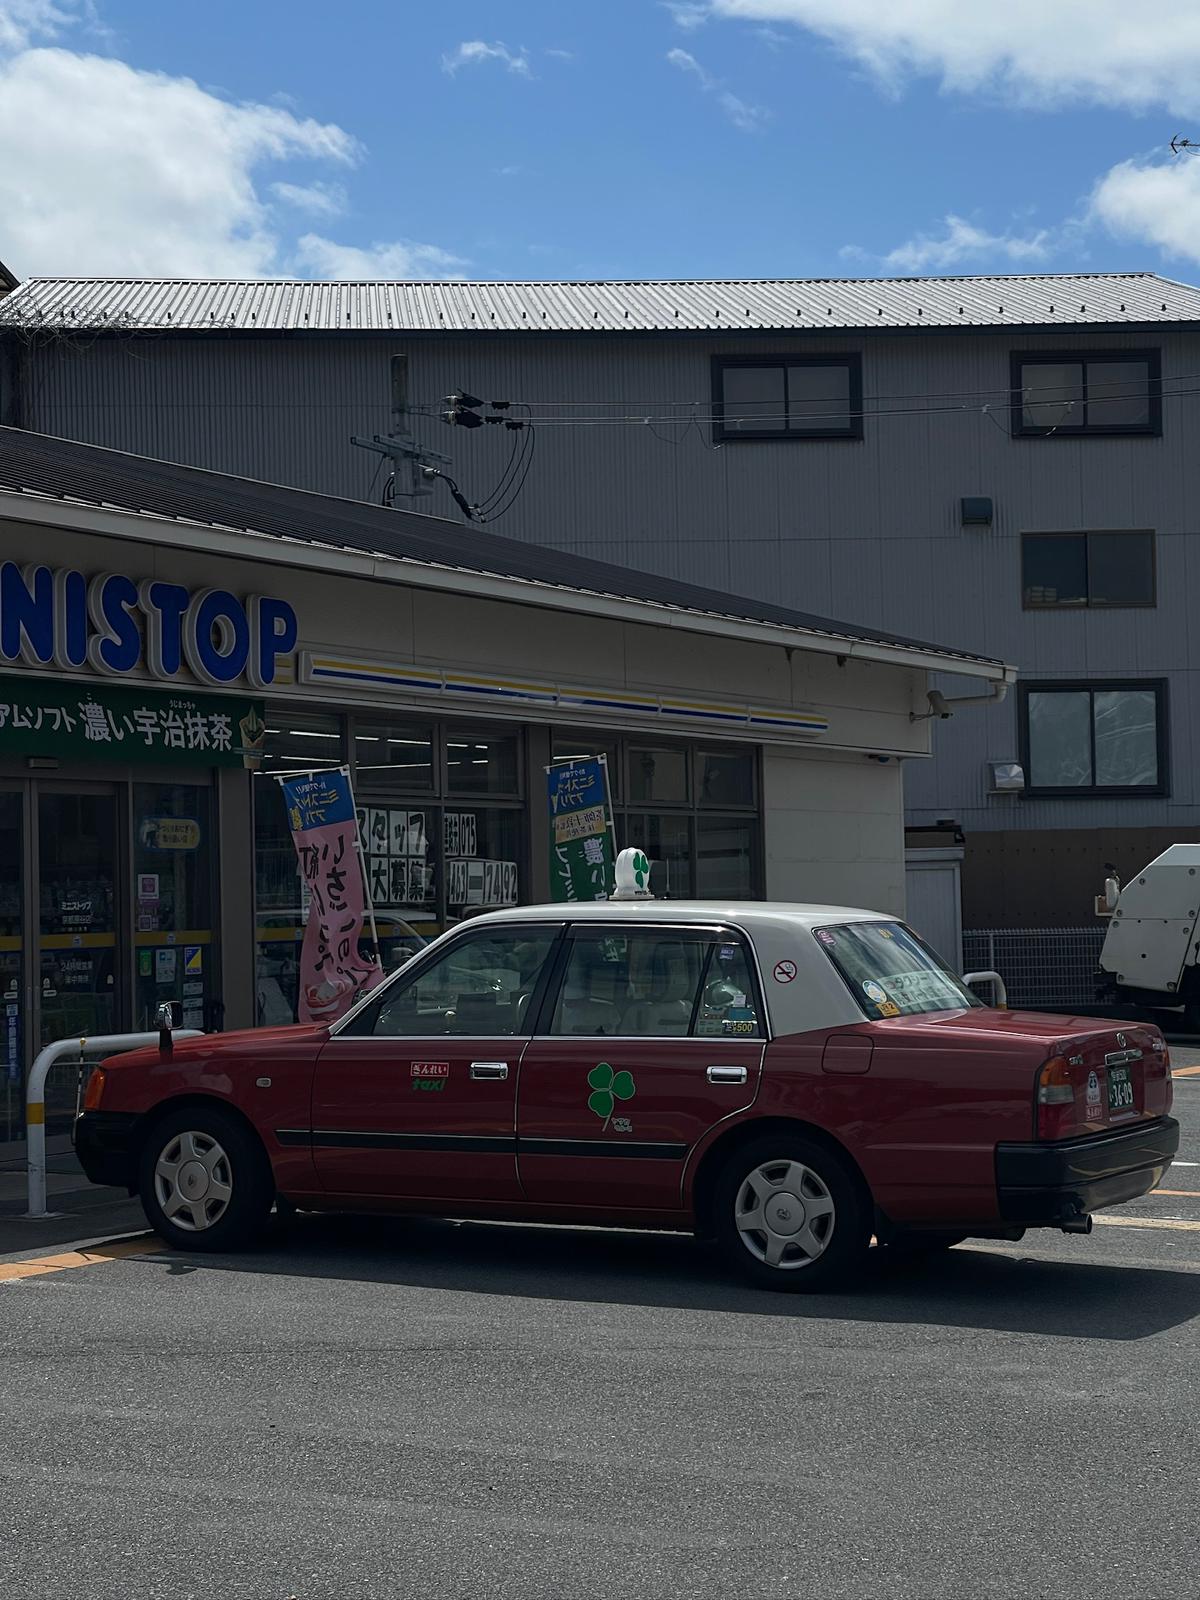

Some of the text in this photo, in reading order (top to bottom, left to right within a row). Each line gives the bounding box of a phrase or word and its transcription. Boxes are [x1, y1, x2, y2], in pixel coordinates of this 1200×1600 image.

[0, 561, 297, 685] NISTOP
[77, 702, 233, 751] 濃い宇治抹茶
[372, 859, 425, 901] 大募集
[412, 1077, 446, 1091] taxi
